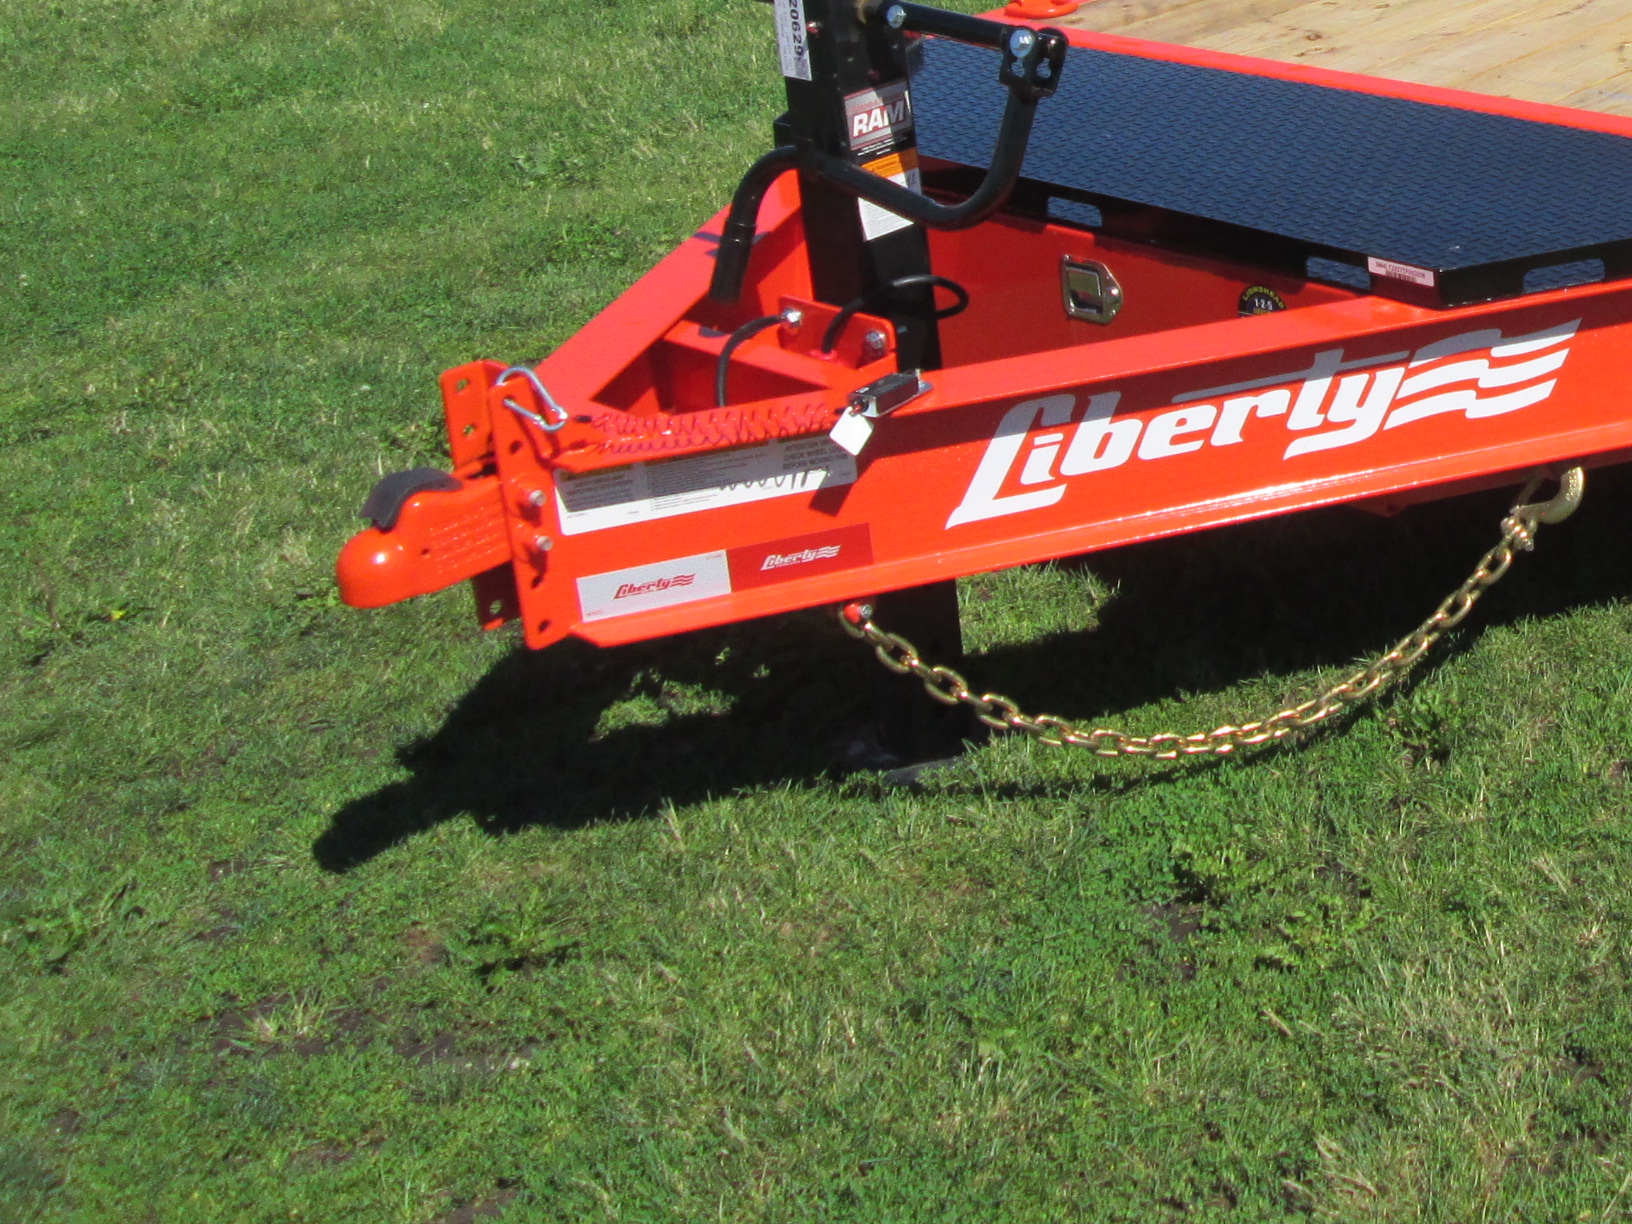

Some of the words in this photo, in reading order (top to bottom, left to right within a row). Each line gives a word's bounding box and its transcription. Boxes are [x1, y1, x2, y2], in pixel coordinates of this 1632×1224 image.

[852, 98, 905, 137] RAM
[1242, 286, 1284, 309] LIONSHEAD
[946, 349, 1409, 529] Liberty
[761, 548, 817, 571] Liberty
[613, 577, 671, 600] Liberty
